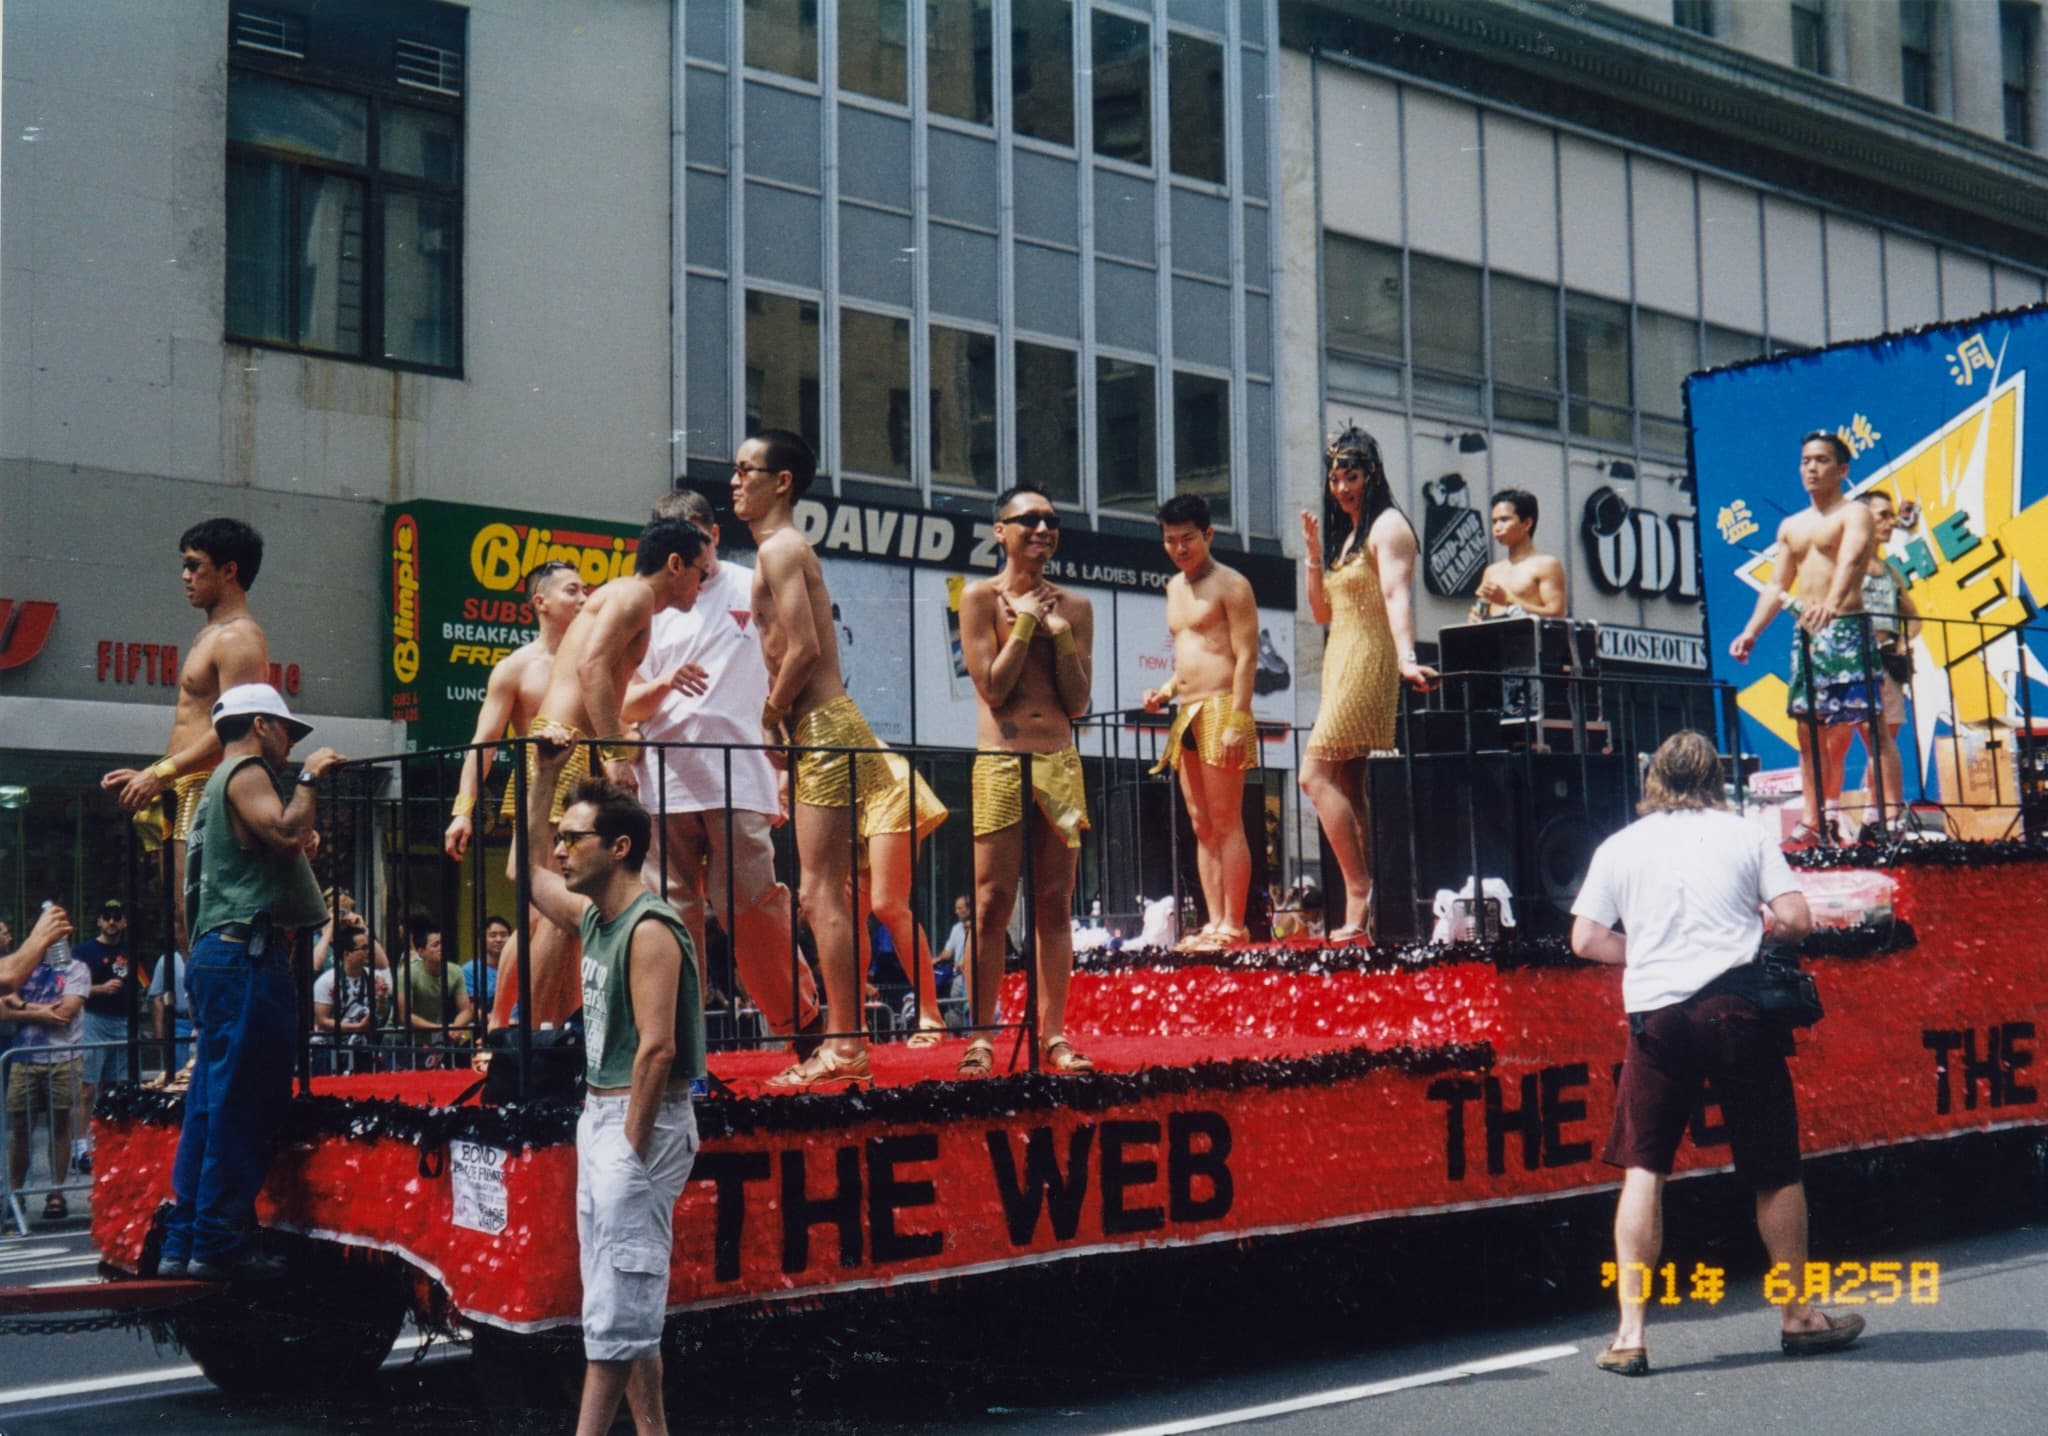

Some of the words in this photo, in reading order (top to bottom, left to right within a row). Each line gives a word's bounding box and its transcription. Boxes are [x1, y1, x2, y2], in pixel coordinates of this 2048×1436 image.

[793, 499, 954, 562] DAVID
[1042, 560, 1061, 578] EN
[1066, 563, 1077, 579] &
[1082, 564, 1137, 585] LADIES
[393, 525, 420, 684] Blimpie
[463, 598, 534, 625] SUBS
[97, 639, 179, 685] FIFTH
[446, 686, 487, 701] LUNC
[1922, 1021, 2038, 1115] THE
[1427, 1062, 1592, 1181] THE
[688, 1133, 944, 1283] THE
[985, 1110, 1235, 1247] WEB
